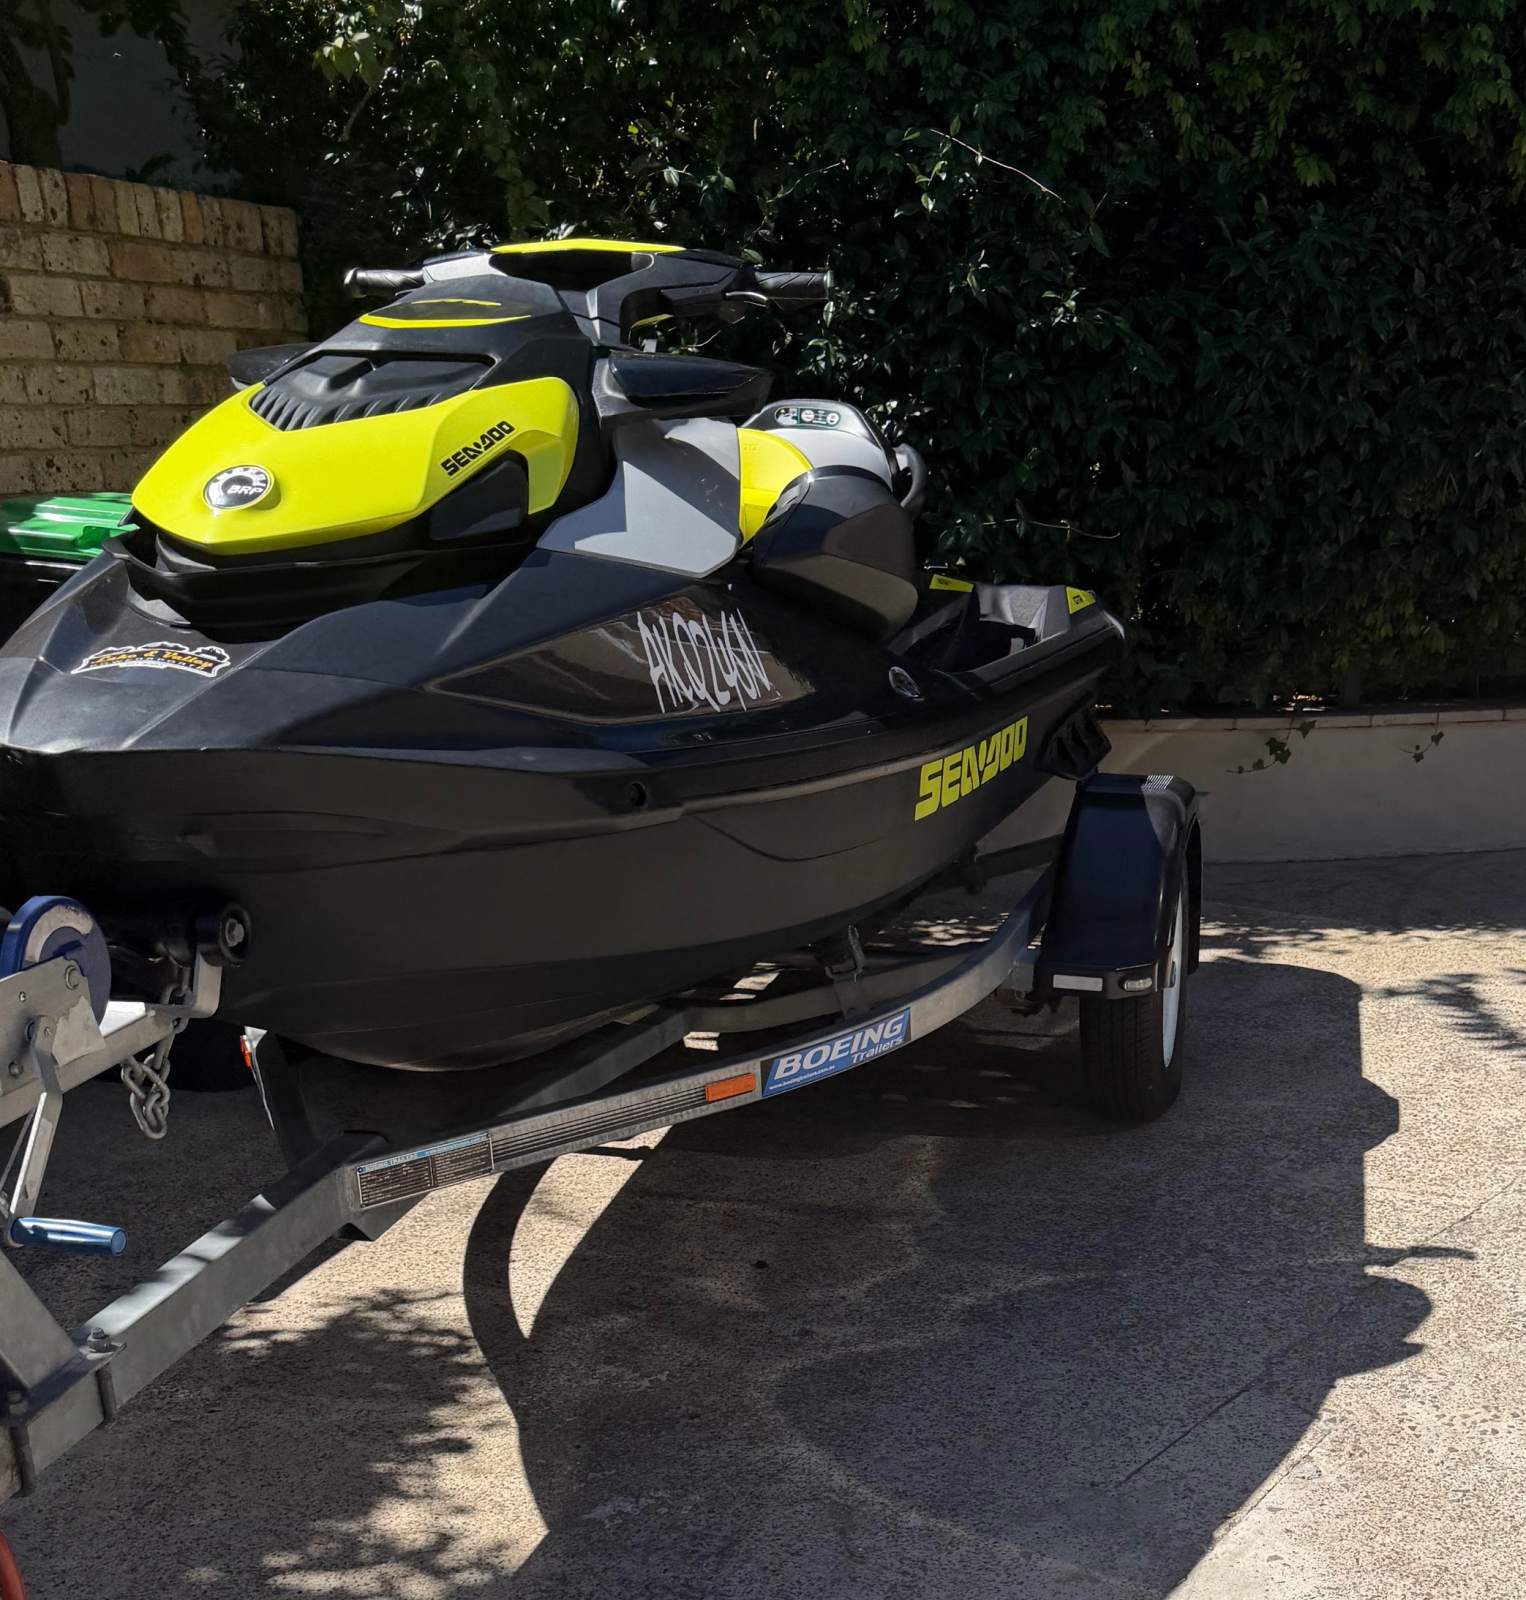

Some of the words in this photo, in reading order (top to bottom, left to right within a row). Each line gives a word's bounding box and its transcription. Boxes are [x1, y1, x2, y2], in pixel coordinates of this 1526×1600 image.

[227, 484, 263, 495] BRP
[162, 651, 213, 669] Valley
[637, 608, 770, 713] AKQ246N
[774, 1015, 905, 1080] BOEING
[851, 1037, 904, 1064] Trailers
